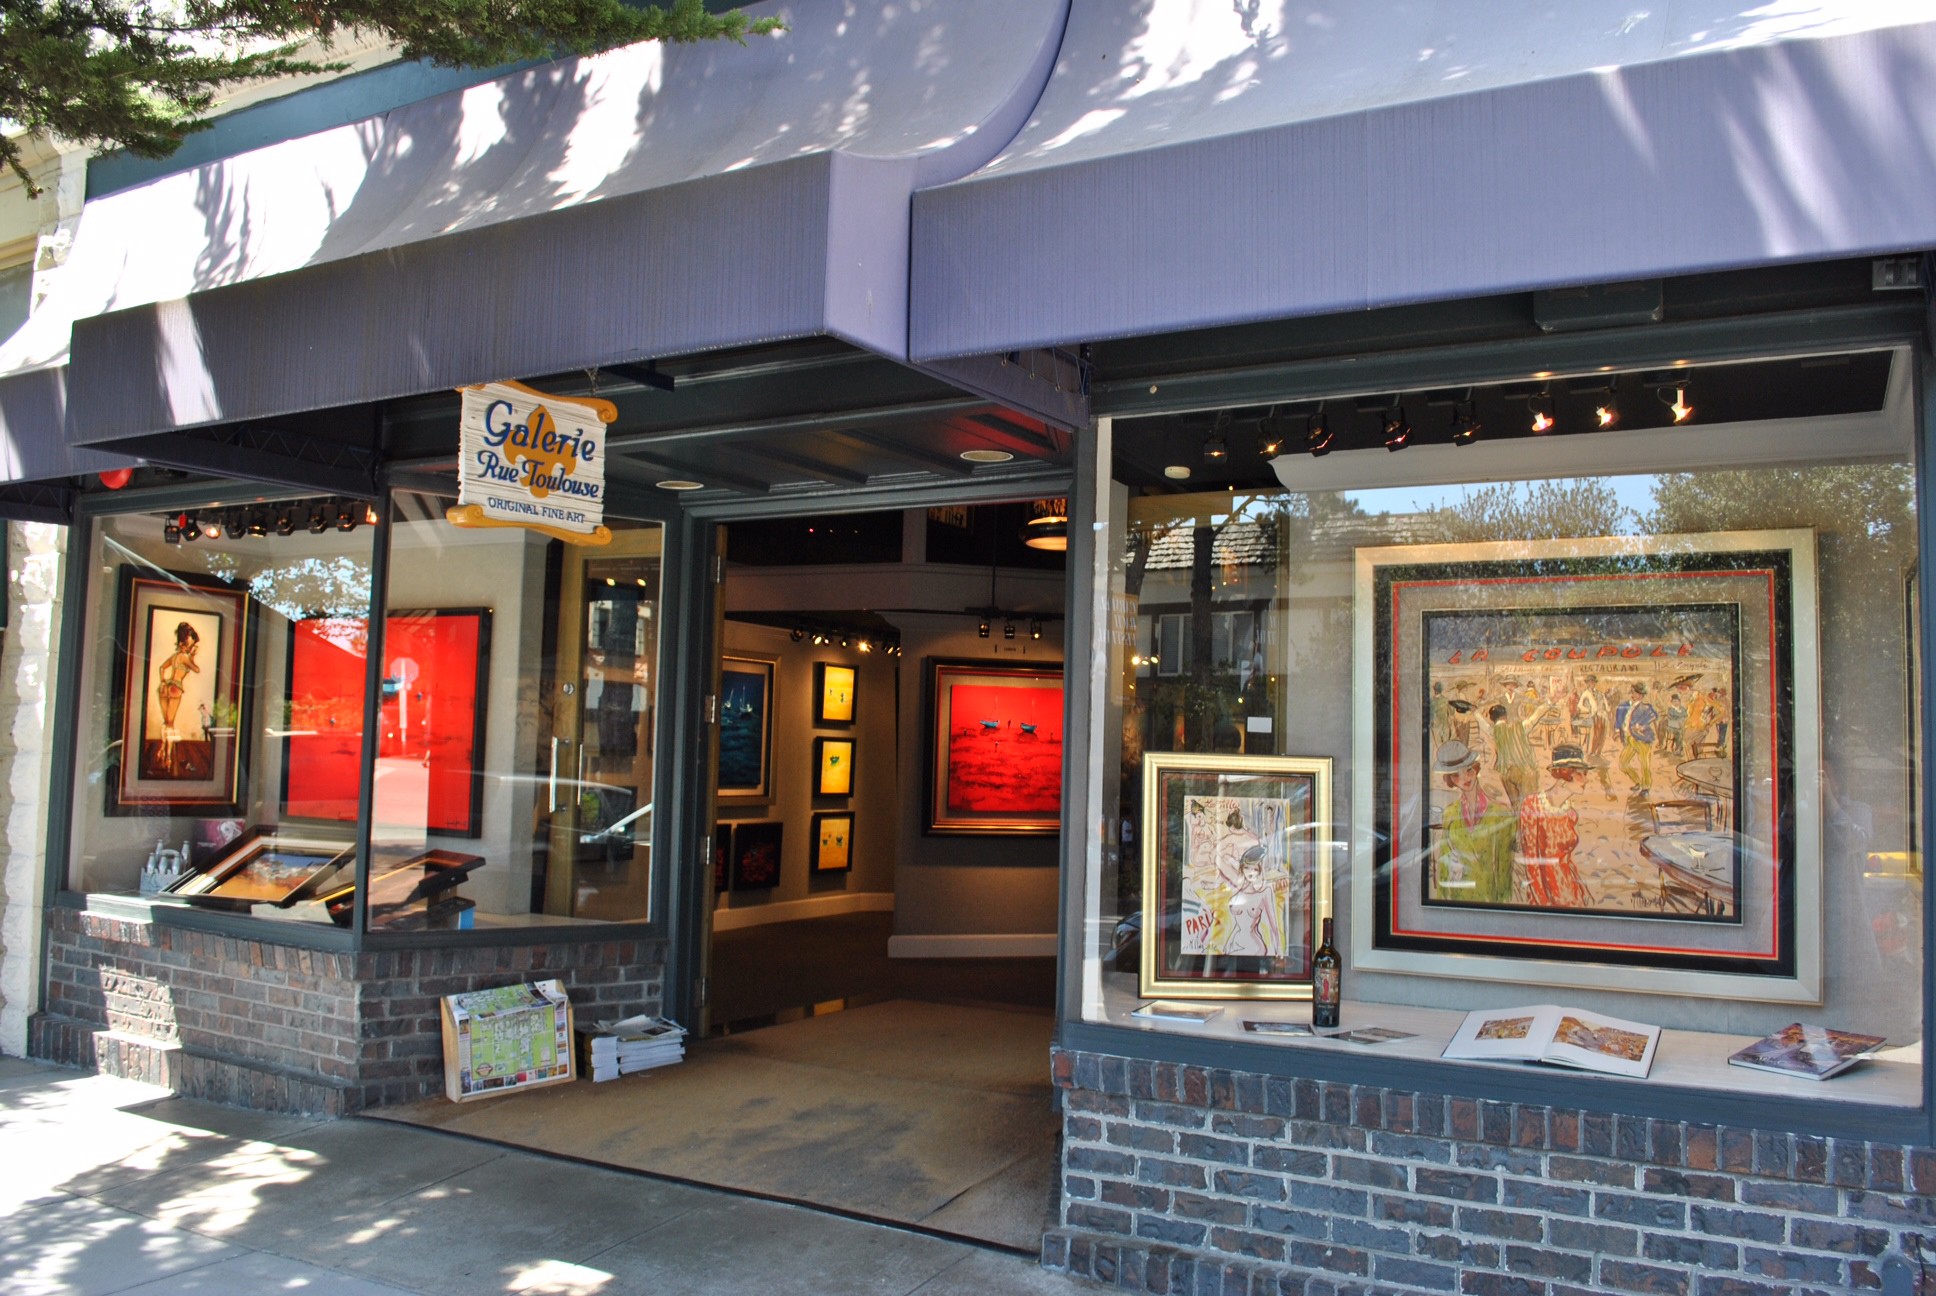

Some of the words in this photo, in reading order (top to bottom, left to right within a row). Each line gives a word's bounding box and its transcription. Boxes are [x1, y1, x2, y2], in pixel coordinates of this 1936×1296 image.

[484, 400, 596, 461] Galerie
[477, 450, 519, 482] Rue
[522, 459, 600, 498] Toulouse
[488, 497, 539, 515] ORIGINAL
[542, 505, 565, 520] FINE
[566, 511, 586, 524] ART
[1447, 647, 1489, 665] LA
[1521, 642, 1695, 662] COUPOLE
